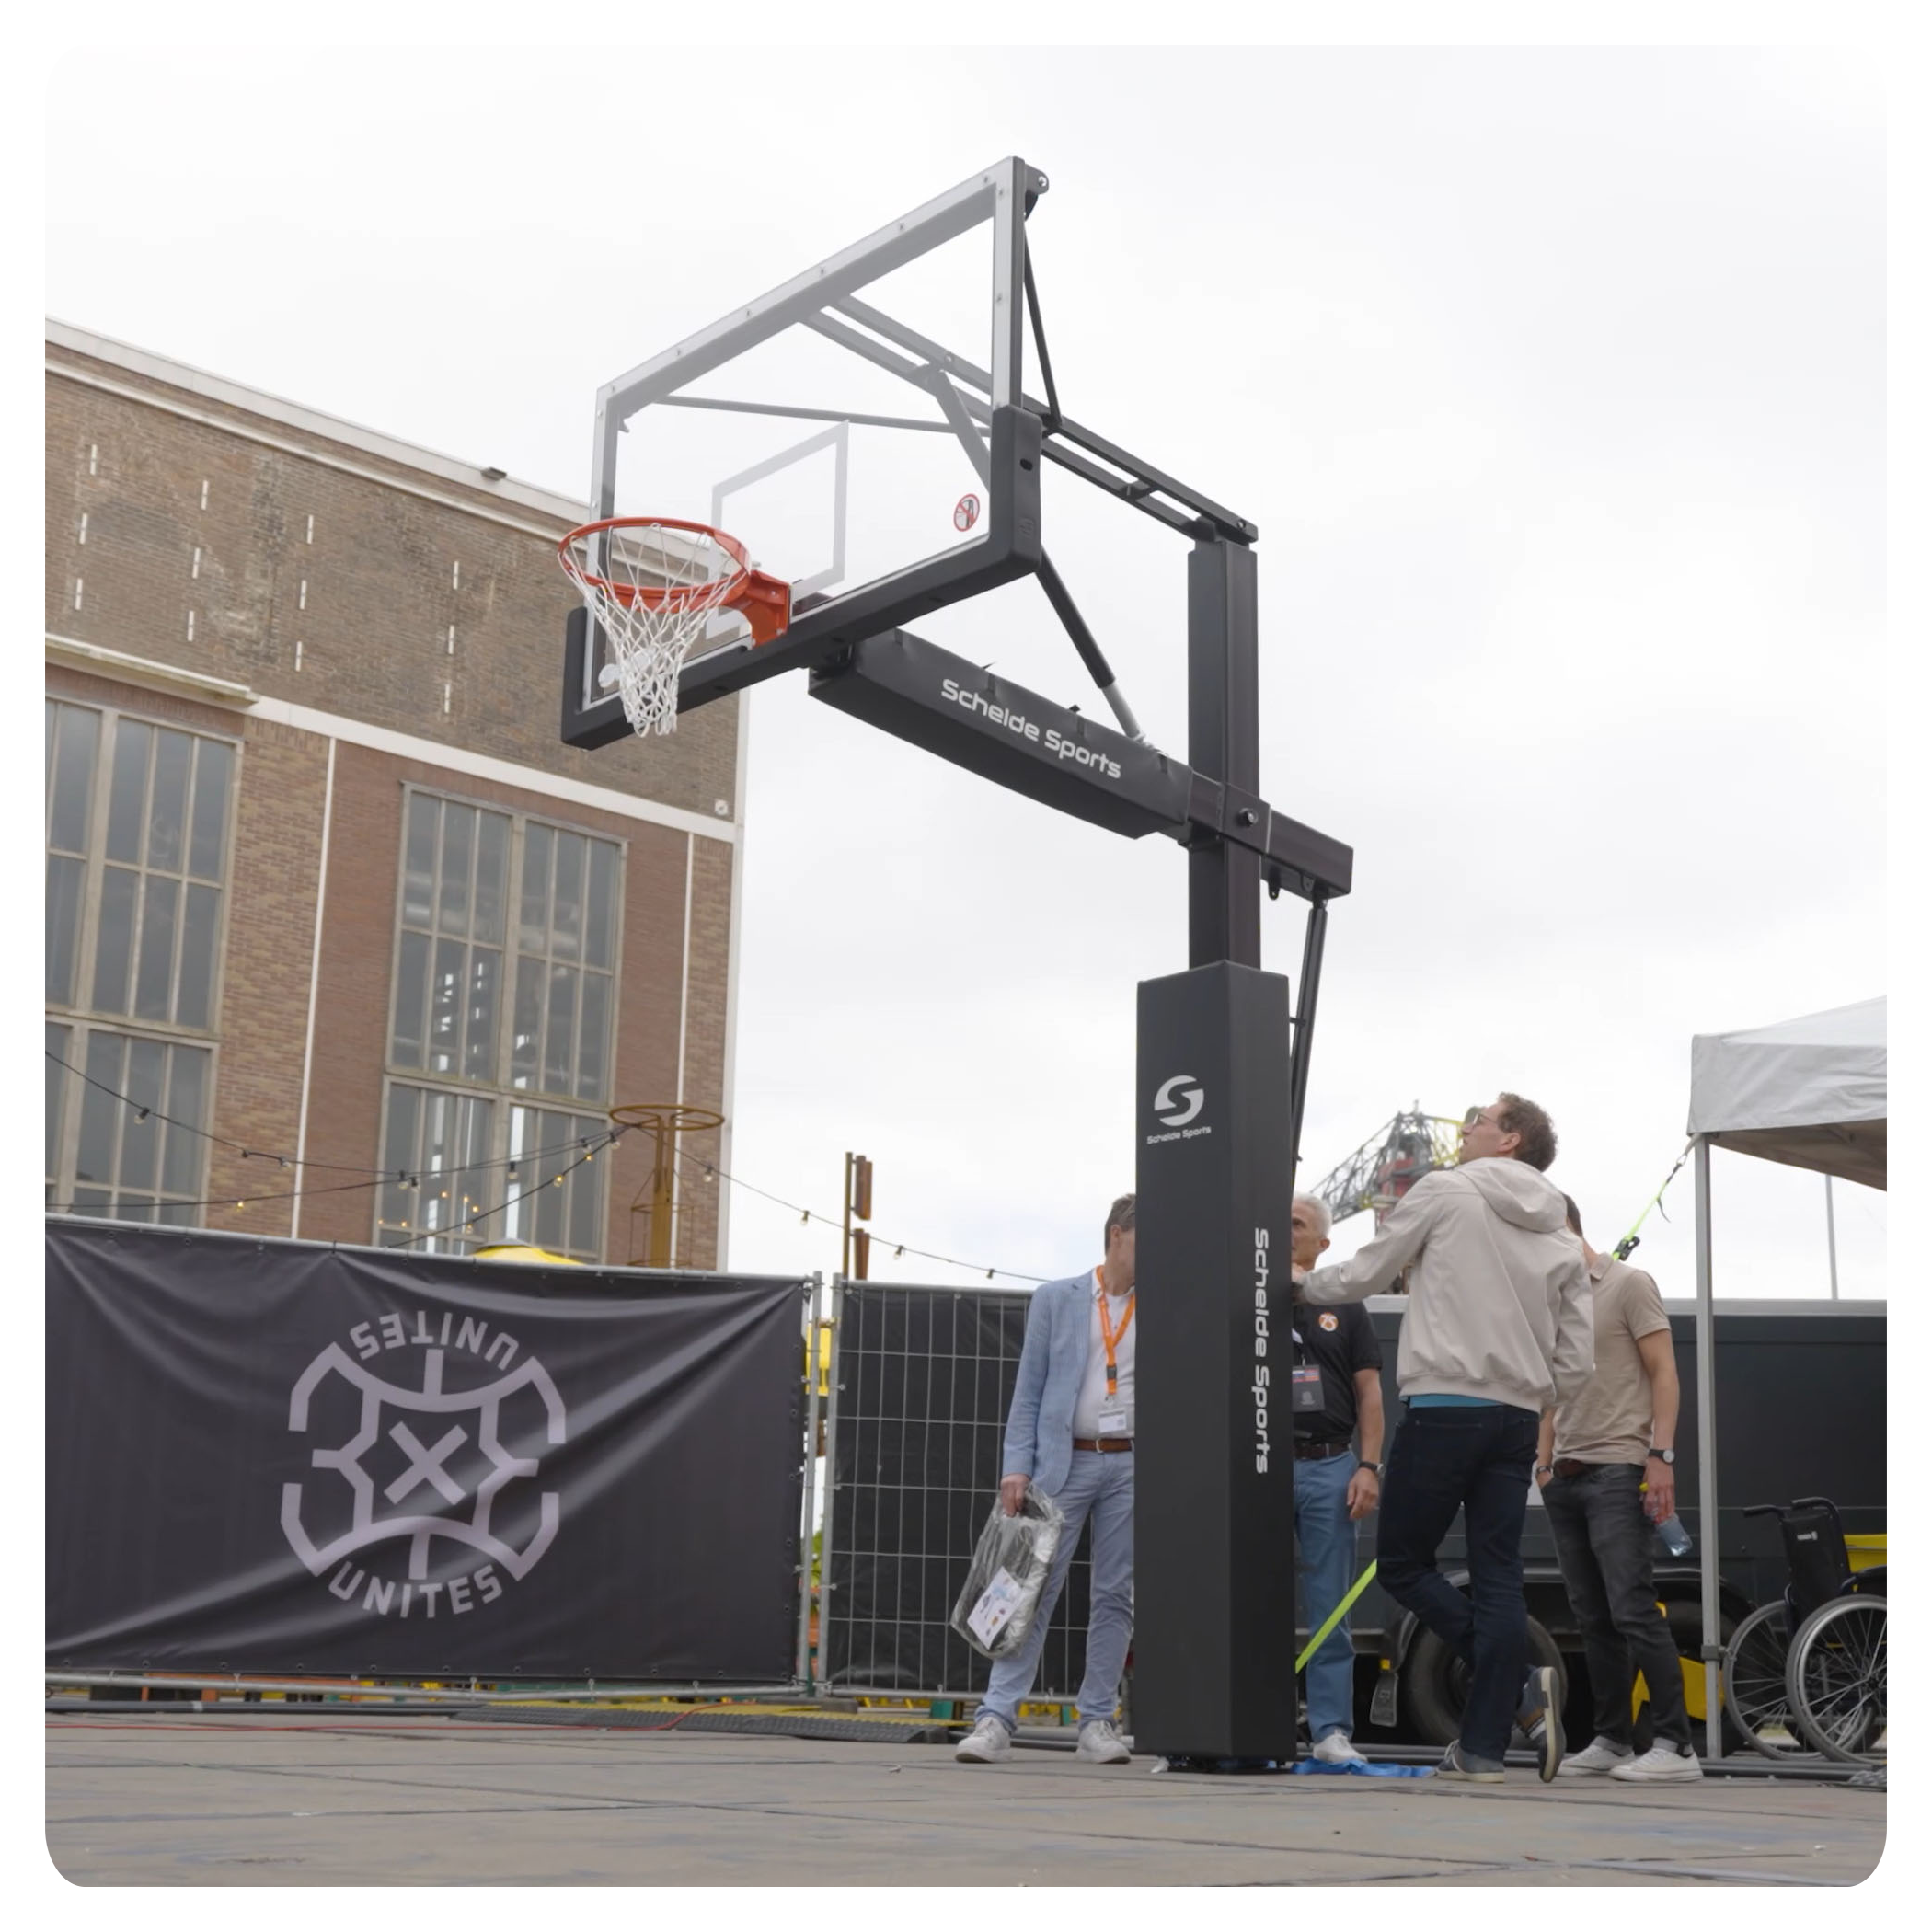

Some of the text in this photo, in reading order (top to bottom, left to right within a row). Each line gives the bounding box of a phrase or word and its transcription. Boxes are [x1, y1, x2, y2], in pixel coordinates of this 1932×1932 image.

[941, 678, 1121, 779] Schelde Sports
[1146, 1126, 1212, 1144] Schelde Sports
[349, 1310, 519, 1371] UNITES
[1251, 1227, 1271, 1475] Schelde Sports
[328, 1561, 503, 1619] UNITES
